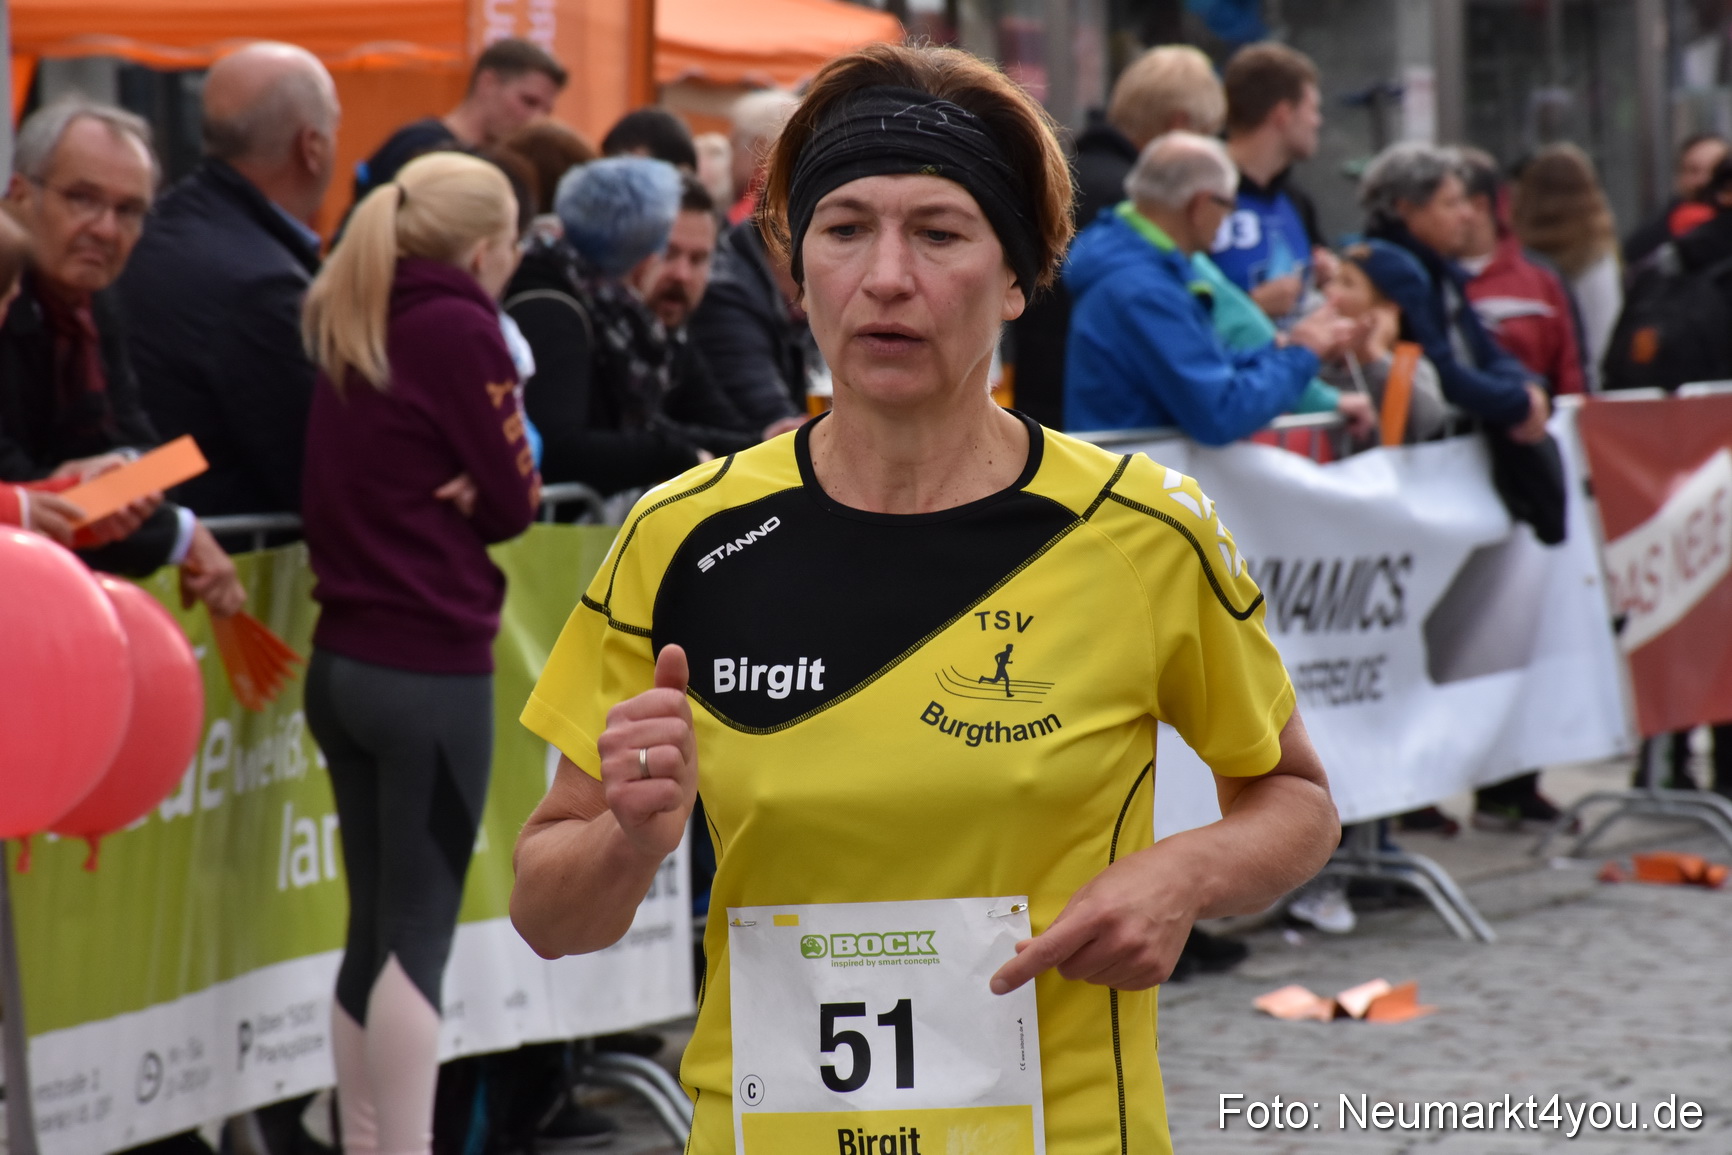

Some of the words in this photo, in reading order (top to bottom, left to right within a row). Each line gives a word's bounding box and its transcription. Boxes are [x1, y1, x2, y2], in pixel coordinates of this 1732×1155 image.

[697, 516, 781, 573] STANNO
[1247, 555, 1411, 633] NAMICS
[974, 610, 1034, 634] TSV
[713, 657, 826, 700] Birgit
[919, 701, 1063, 748] Burgthann
[830, 931, 938, 958] BOCK
[831, 959, 864, 969] inspired
[866, 958, 876, 967] by
[878, 958, 902, 966] smart
[904, 957, 941, 966] concepts
[820, 998, 914, 1093] 51
[747, 1082, 757, 1101] C
[837, 1126, 921, 1155] Birgit
